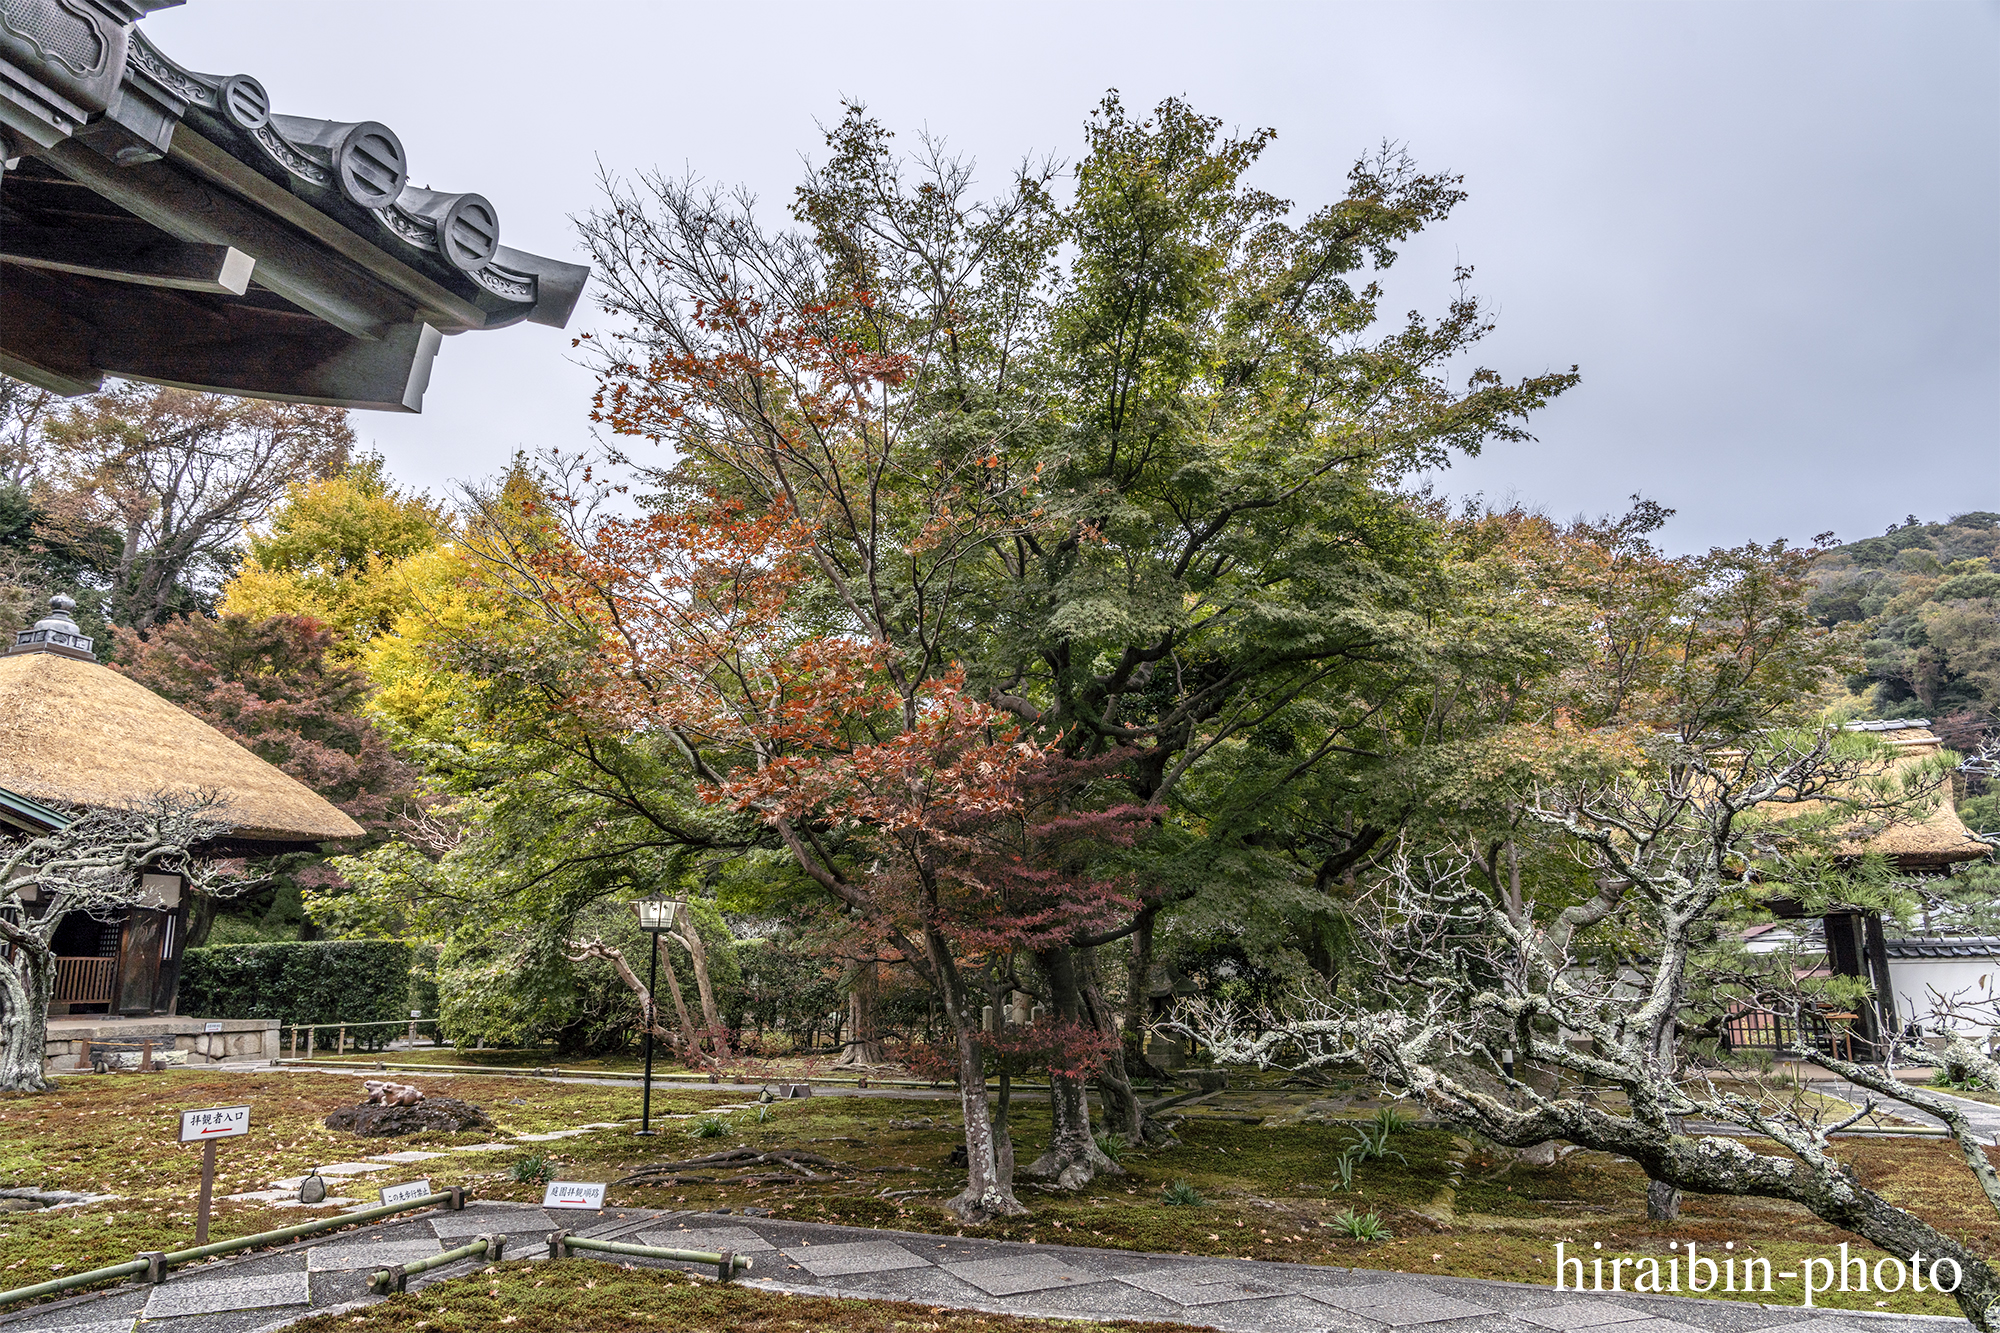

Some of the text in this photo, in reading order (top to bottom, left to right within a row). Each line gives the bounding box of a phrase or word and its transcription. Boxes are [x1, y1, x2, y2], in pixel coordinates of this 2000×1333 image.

[190, 1111, 244, 1127] 拝観者入口
[388, 1187, 430, 1202] この先歩行禁止
[550, 1186, 600, 1199] 庭園拝観順路
